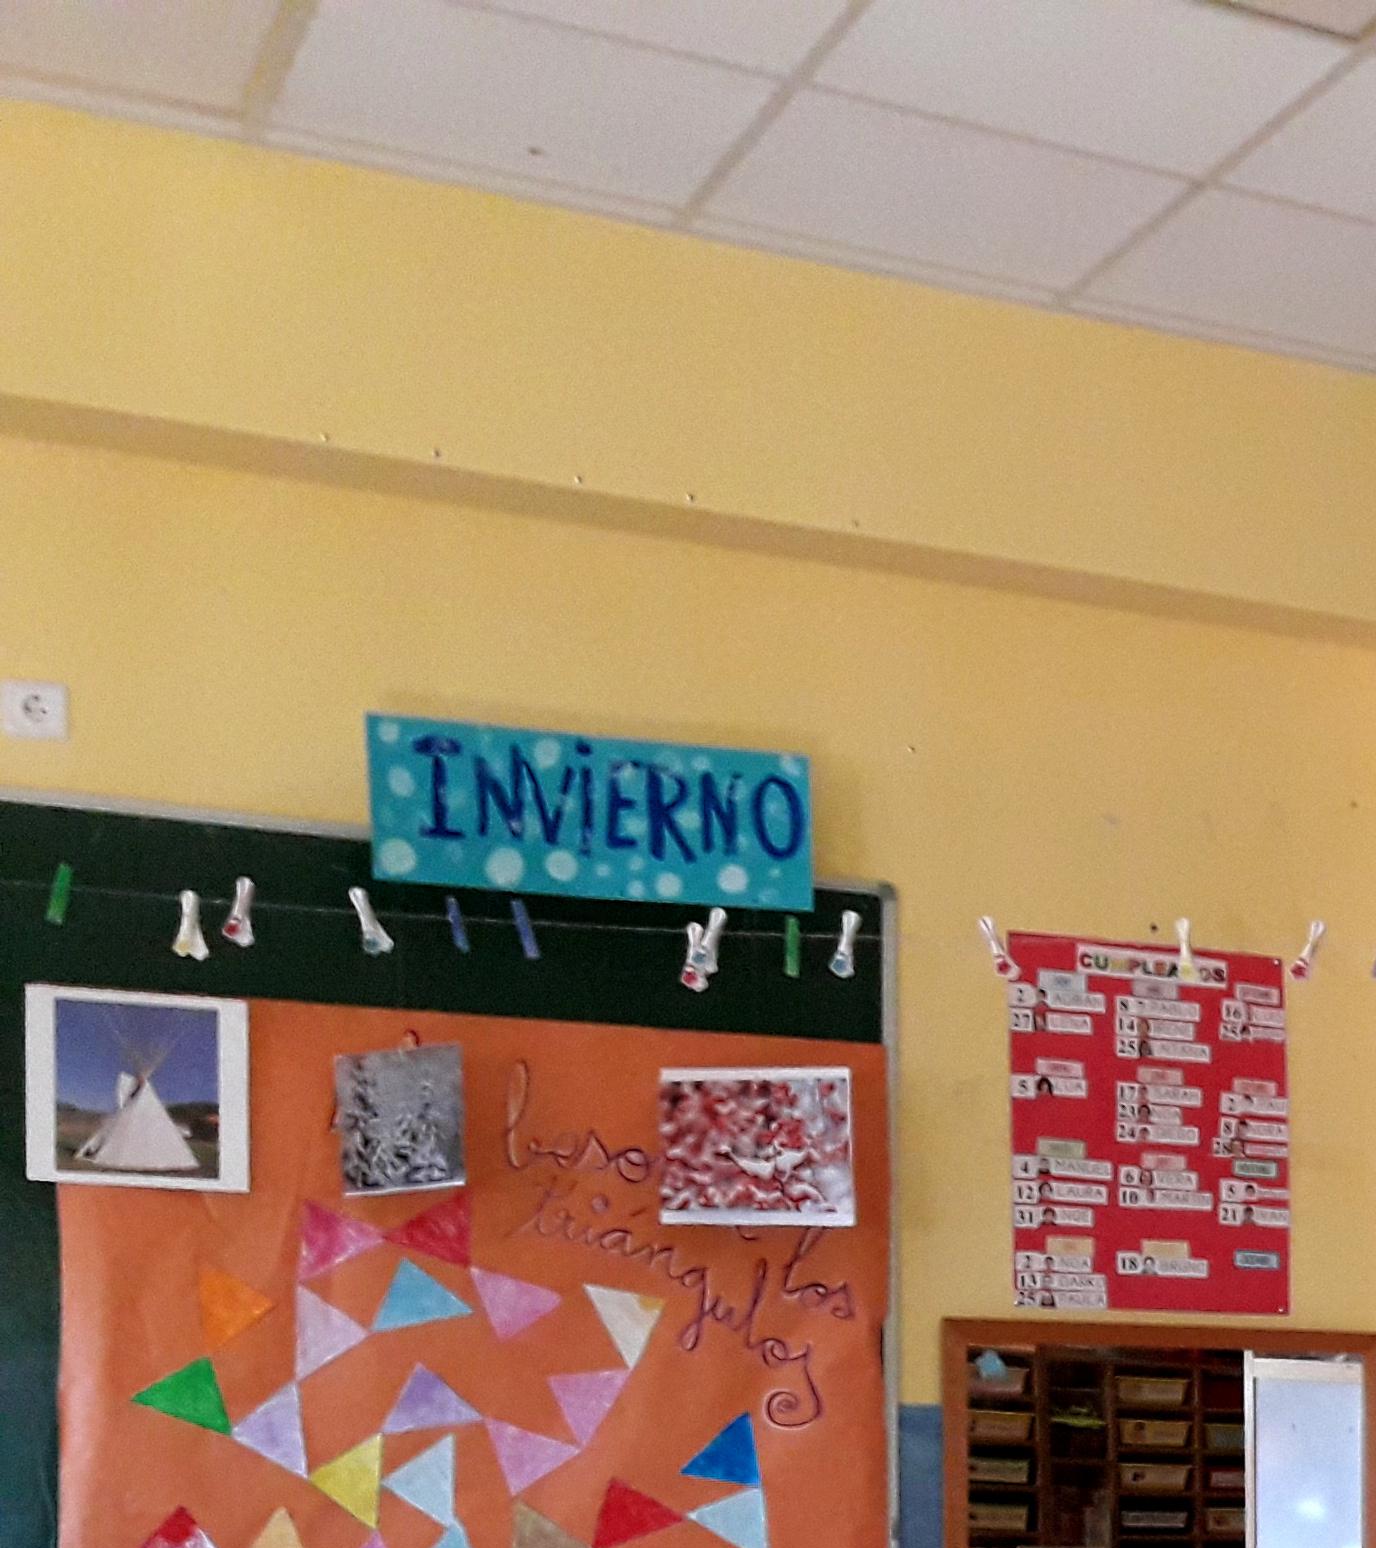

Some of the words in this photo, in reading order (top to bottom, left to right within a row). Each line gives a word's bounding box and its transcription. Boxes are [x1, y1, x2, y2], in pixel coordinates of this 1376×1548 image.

[1079, 952, 1226, 983] CUMPLEAOS
[1118, 1017, 1136, 1032] 14
[1118, 1040, 1137, 1055] 25
[1119, 1085, 1137, 1100] 17
[1017, 1186, 1034, 1200] 12
[1017, 1210, 1034, 1224] 31
[1120, 1255, 1138, 1271] 18
